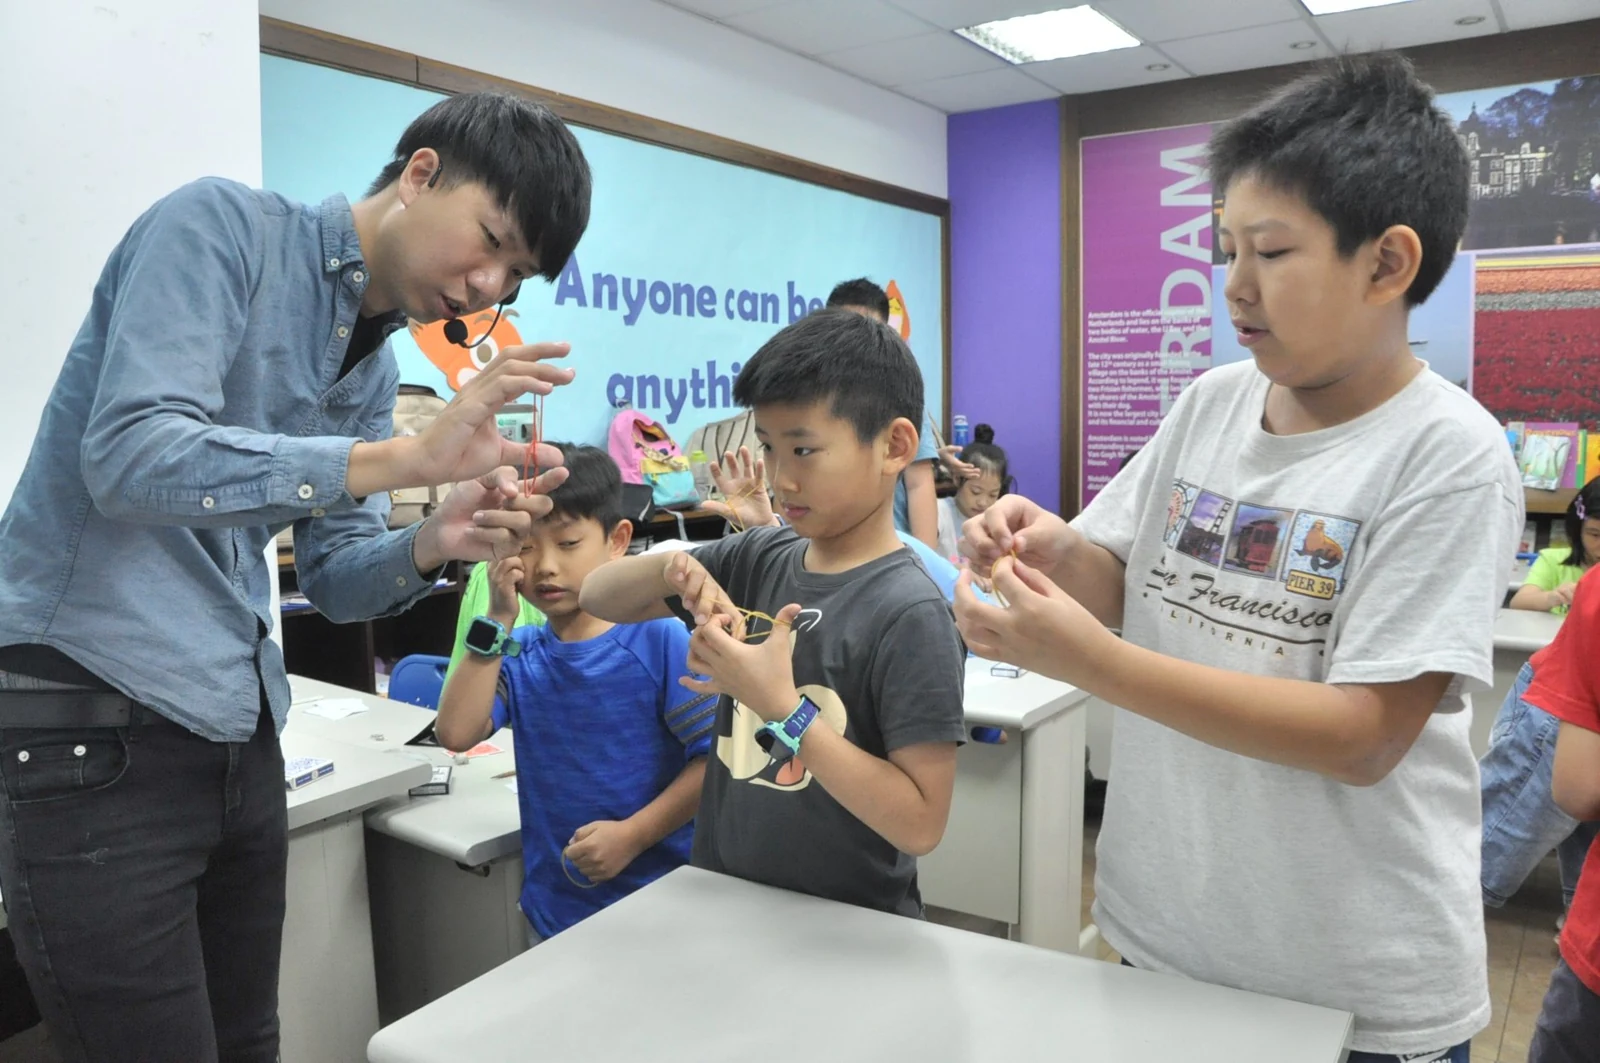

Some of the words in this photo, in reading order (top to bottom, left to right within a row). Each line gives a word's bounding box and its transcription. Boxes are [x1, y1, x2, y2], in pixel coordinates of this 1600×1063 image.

[555, 252, 717, 326] Anyone
[725, 288, 779, 324] can
[1088, 311, 1123, 319] Amsterdam
[1130, 309, 1141, 317] the
[1088, 319, 1125, 327] Netherlands
[1126, 318, 1138, 326] and
[1101, 327, 1121, 335] bodies
[1151, 325, 1161, 333] the
[1100, 353, 1111, 361] city
[1125, 351, 1154, 361] originally
[1113, 361, 1136, 369] century
[1088, 369, 1108, 377] village
[1129, 368, 1148, 376] banks
[1088, 377, 1118, 386] According
[1102, 401, 1117, 409] their
[1125, 409, 1147, 420] largest
[1147, 410, 1159, 419] city
[1109, 418, 1135, 426] financial
[1136, 418, 1149, 426] and
[1088, 434, 1122, 442] Amsterdam
[1088, 443, 1124, 452] outstanding
[1289, 574, 1315, 592] PIER
[1317, 580, 1333, 595] 39
[1188, 573, 1333, 628] Francisco
[1160, 605, 1284, 656] LIFORNIA
